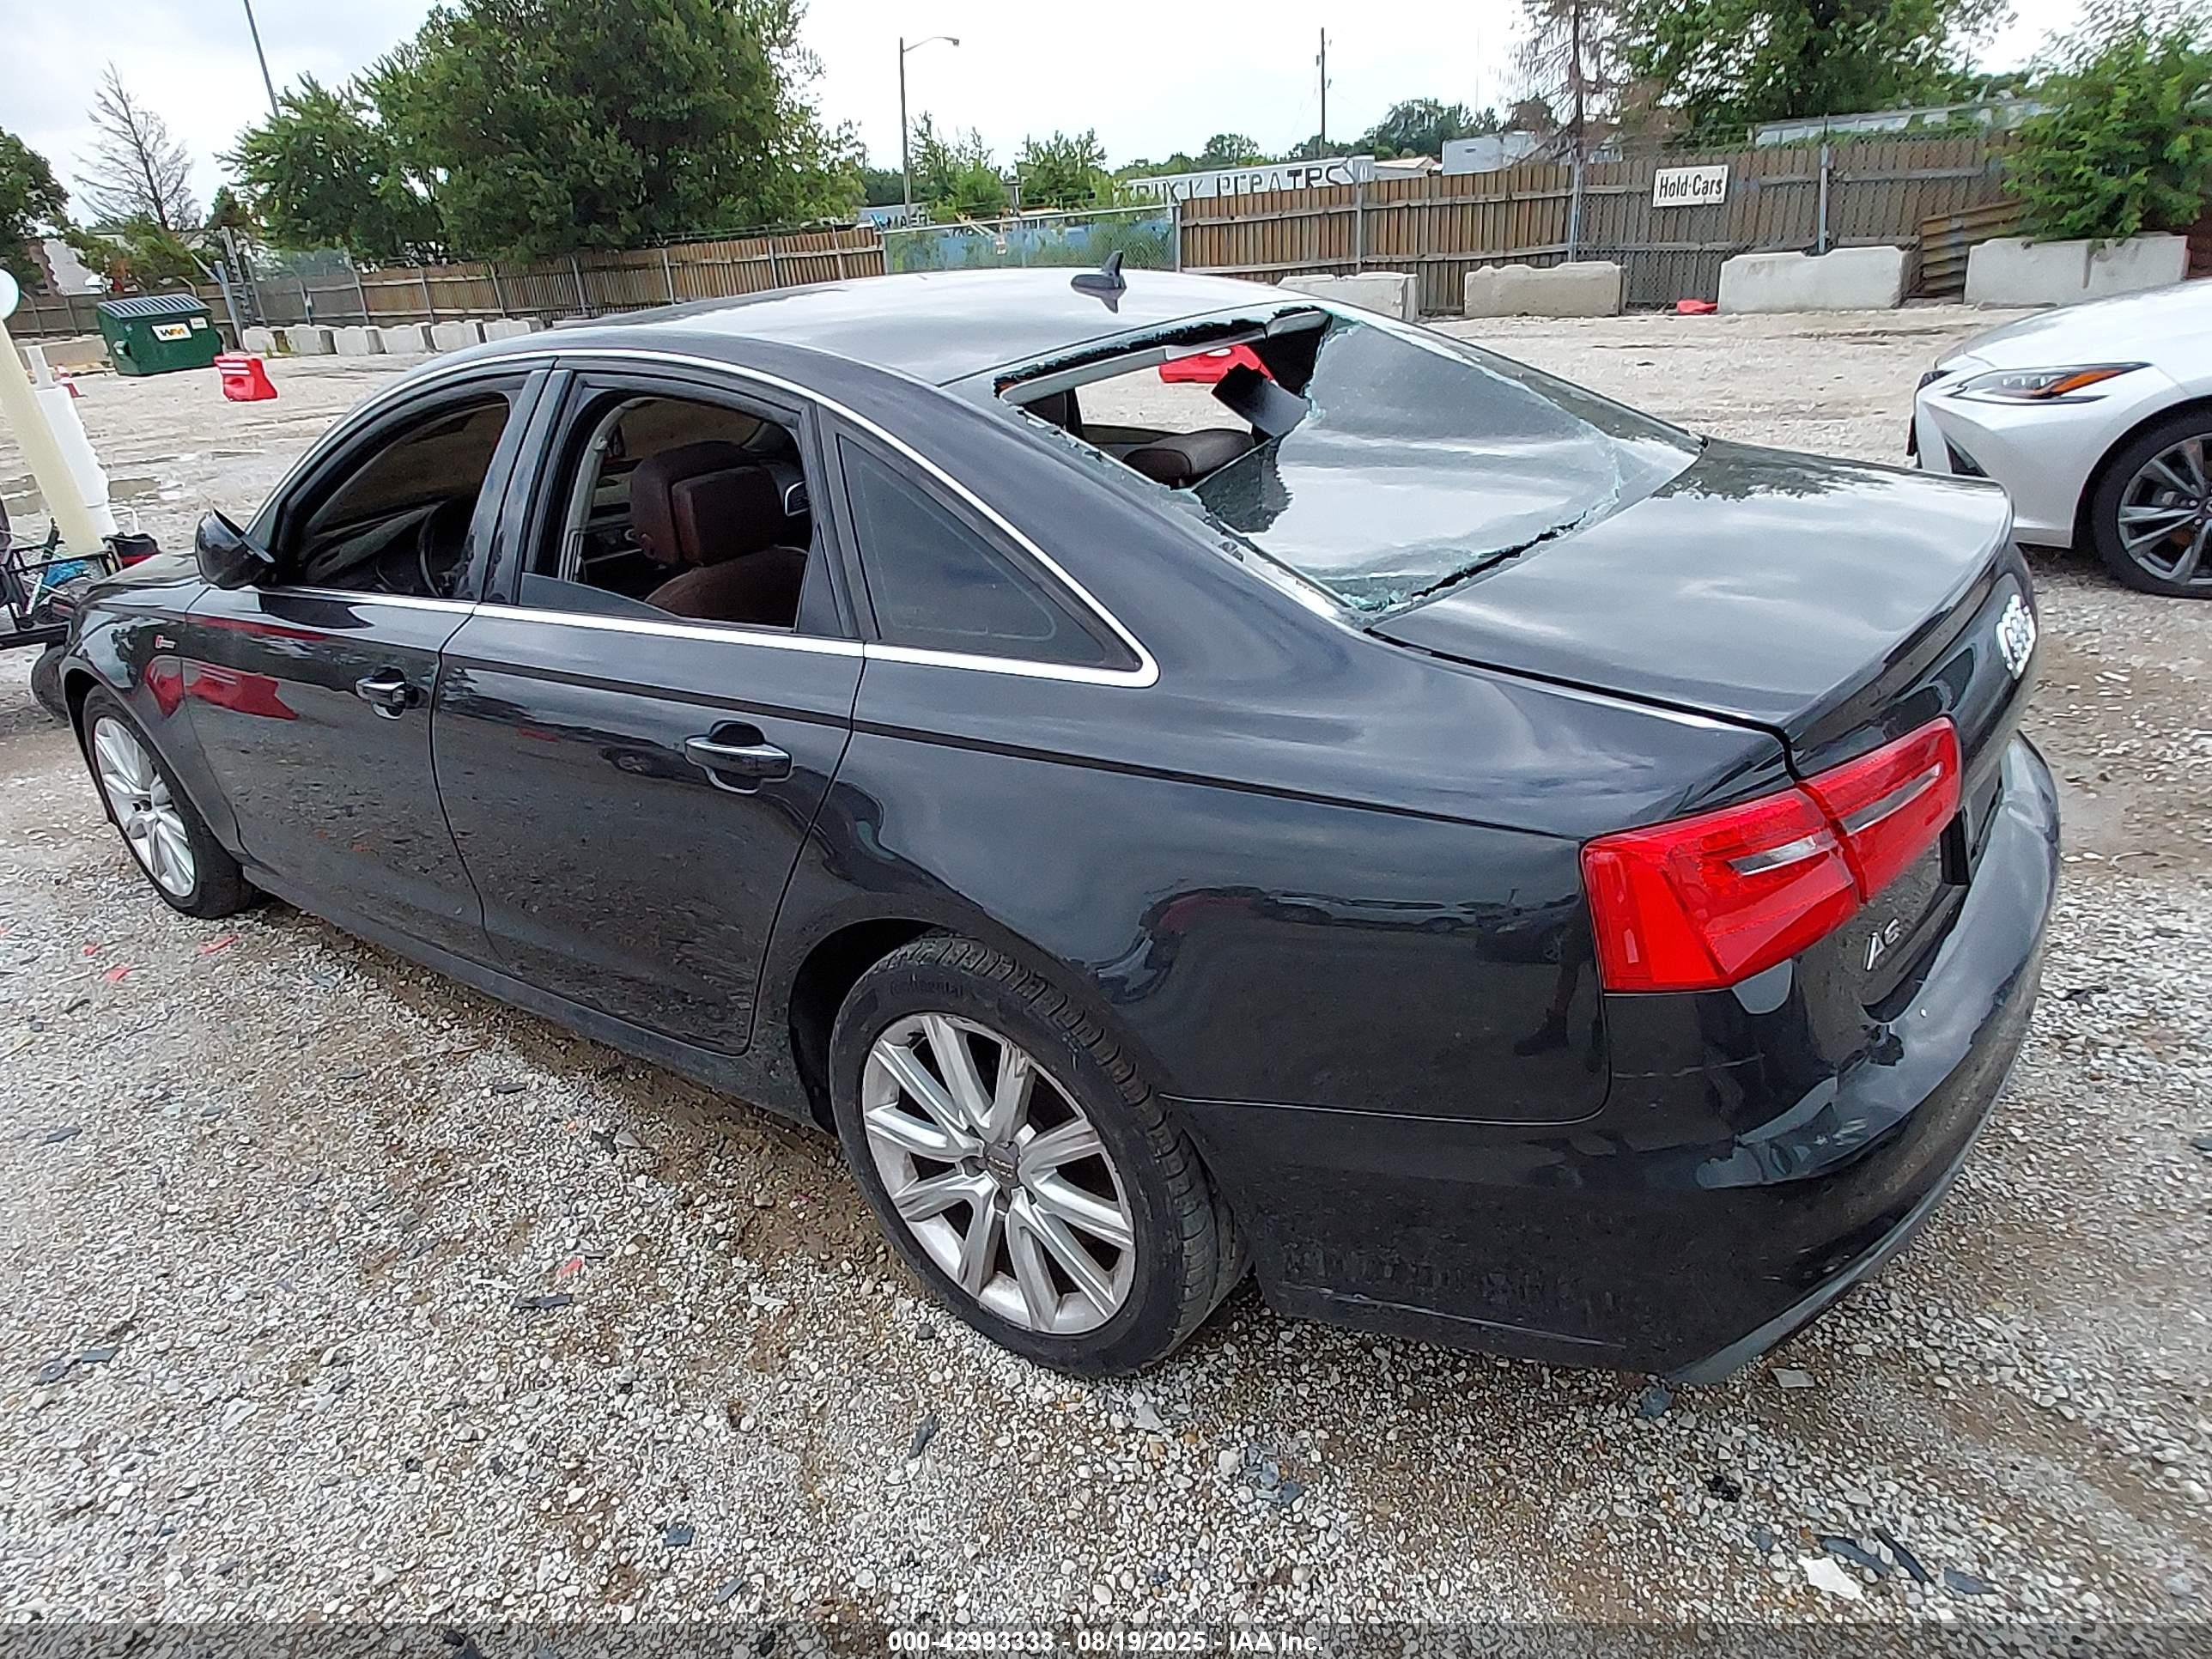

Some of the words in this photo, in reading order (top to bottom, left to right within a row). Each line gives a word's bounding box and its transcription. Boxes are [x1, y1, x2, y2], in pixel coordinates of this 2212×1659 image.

[1659, 174, 1689, 198] Hold
[1692, 173, 1723, 197] Cars
[1862, 917, 1901, 972] A6
